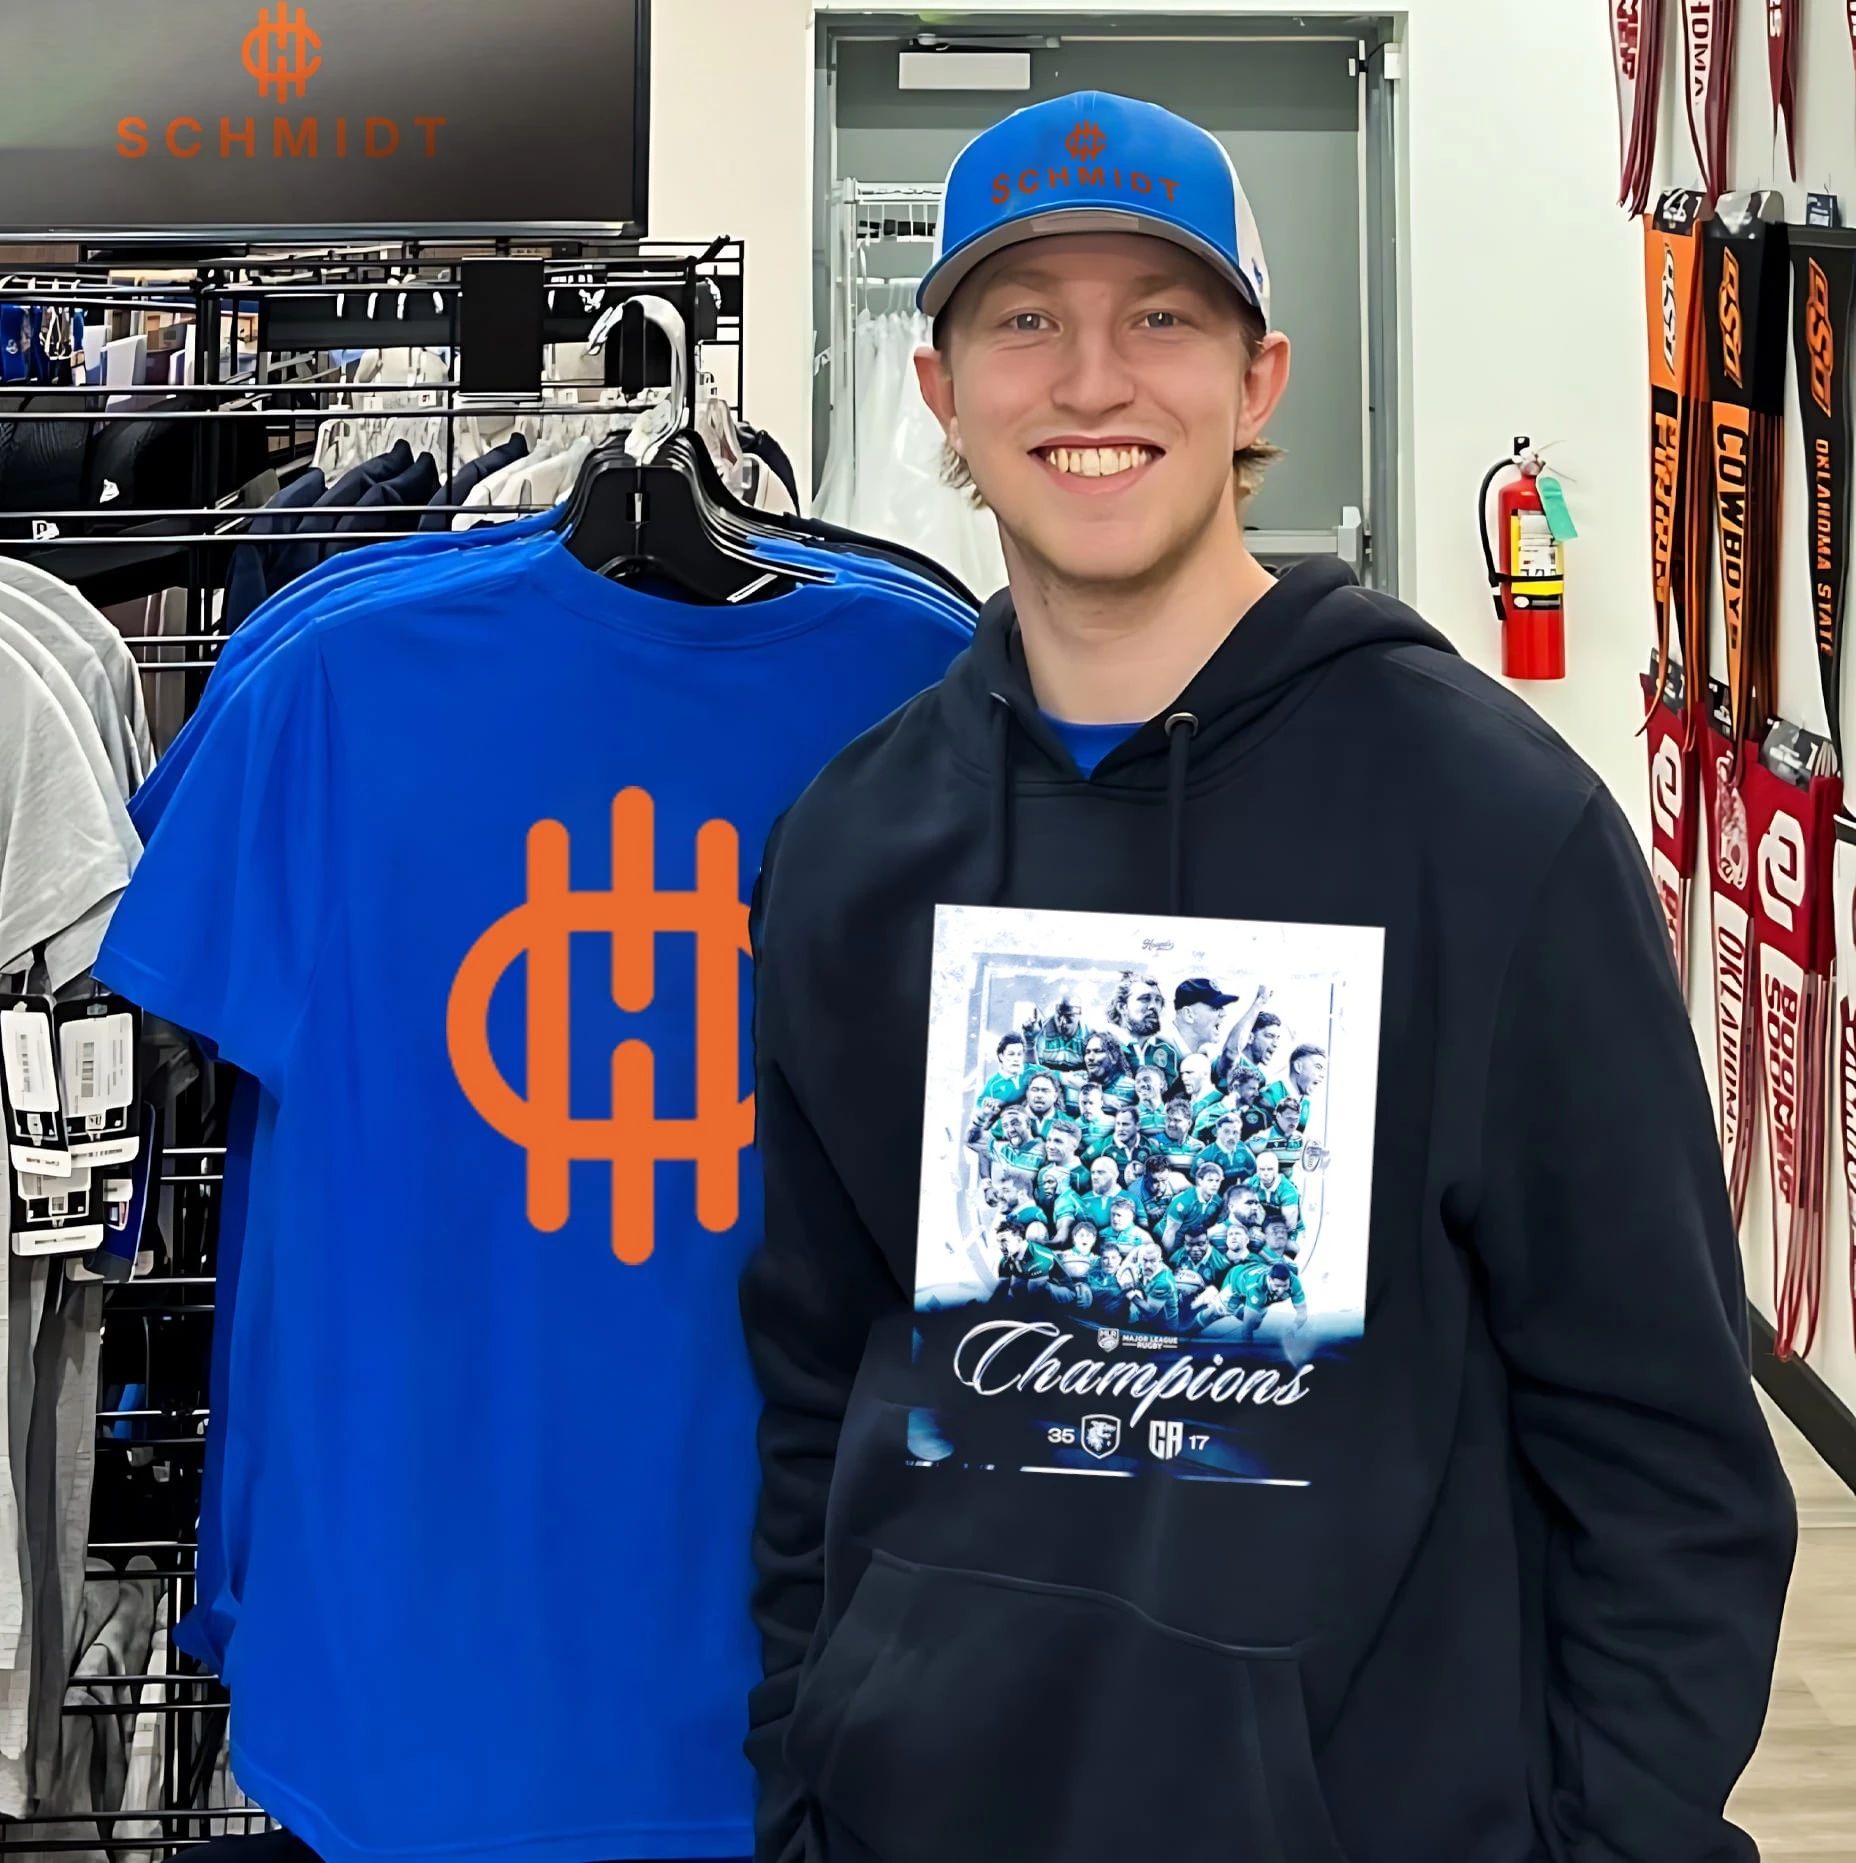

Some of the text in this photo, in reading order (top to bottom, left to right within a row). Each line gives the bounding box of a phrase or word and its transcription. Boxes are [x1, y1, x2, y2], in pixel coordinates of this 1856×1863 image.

[116, 116, 448, 159] SCHMIDT
[991, 166, 1181, 205] SCHMIDT
[1815, 437, 1832, 571] OKLAHOMA
[1718, 925, 1745, 1144] OKLAHOMA
[1122, 1334, 1178, 1344] MAJOR LEAGUE
[1136, 1341, 1164, 1350] RUGBY
[953, 1320, 1315, 1429] Champions
[1048, 1427, 1076, 1445] 35
[1188, 1434, 1211, 1451] 17
